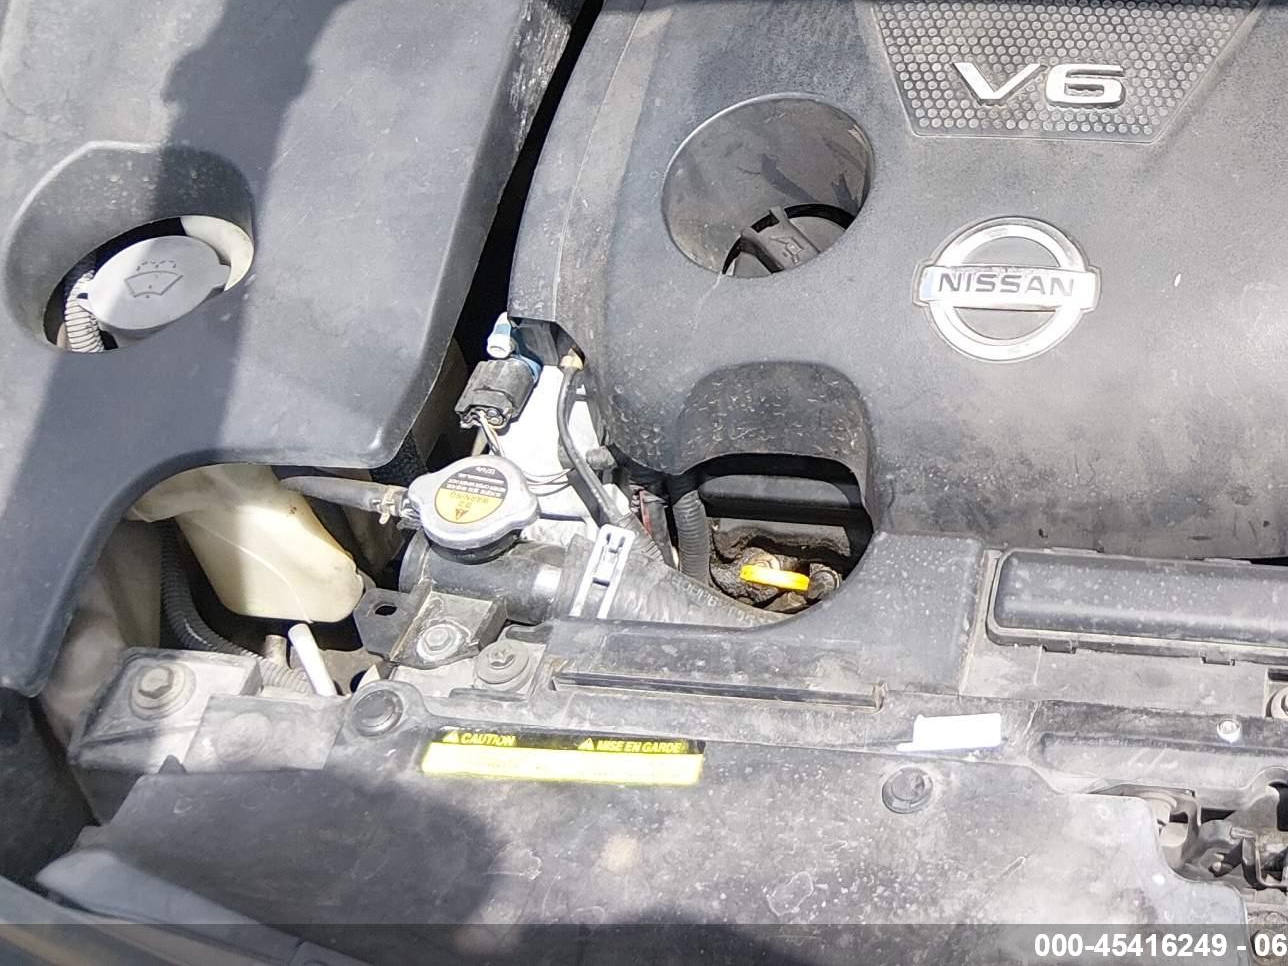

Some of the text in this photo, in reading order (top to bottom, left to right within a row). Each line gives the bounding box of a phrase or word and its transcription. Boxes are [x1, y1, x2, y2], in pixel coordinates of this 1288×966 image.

[951, 62, 1126, 107] V6
[938, 272, 1074, 297] NISSAN
[460, 733, 516, 746] CAUTION
[597, 740, 682, 753] MISE EN GARDE
